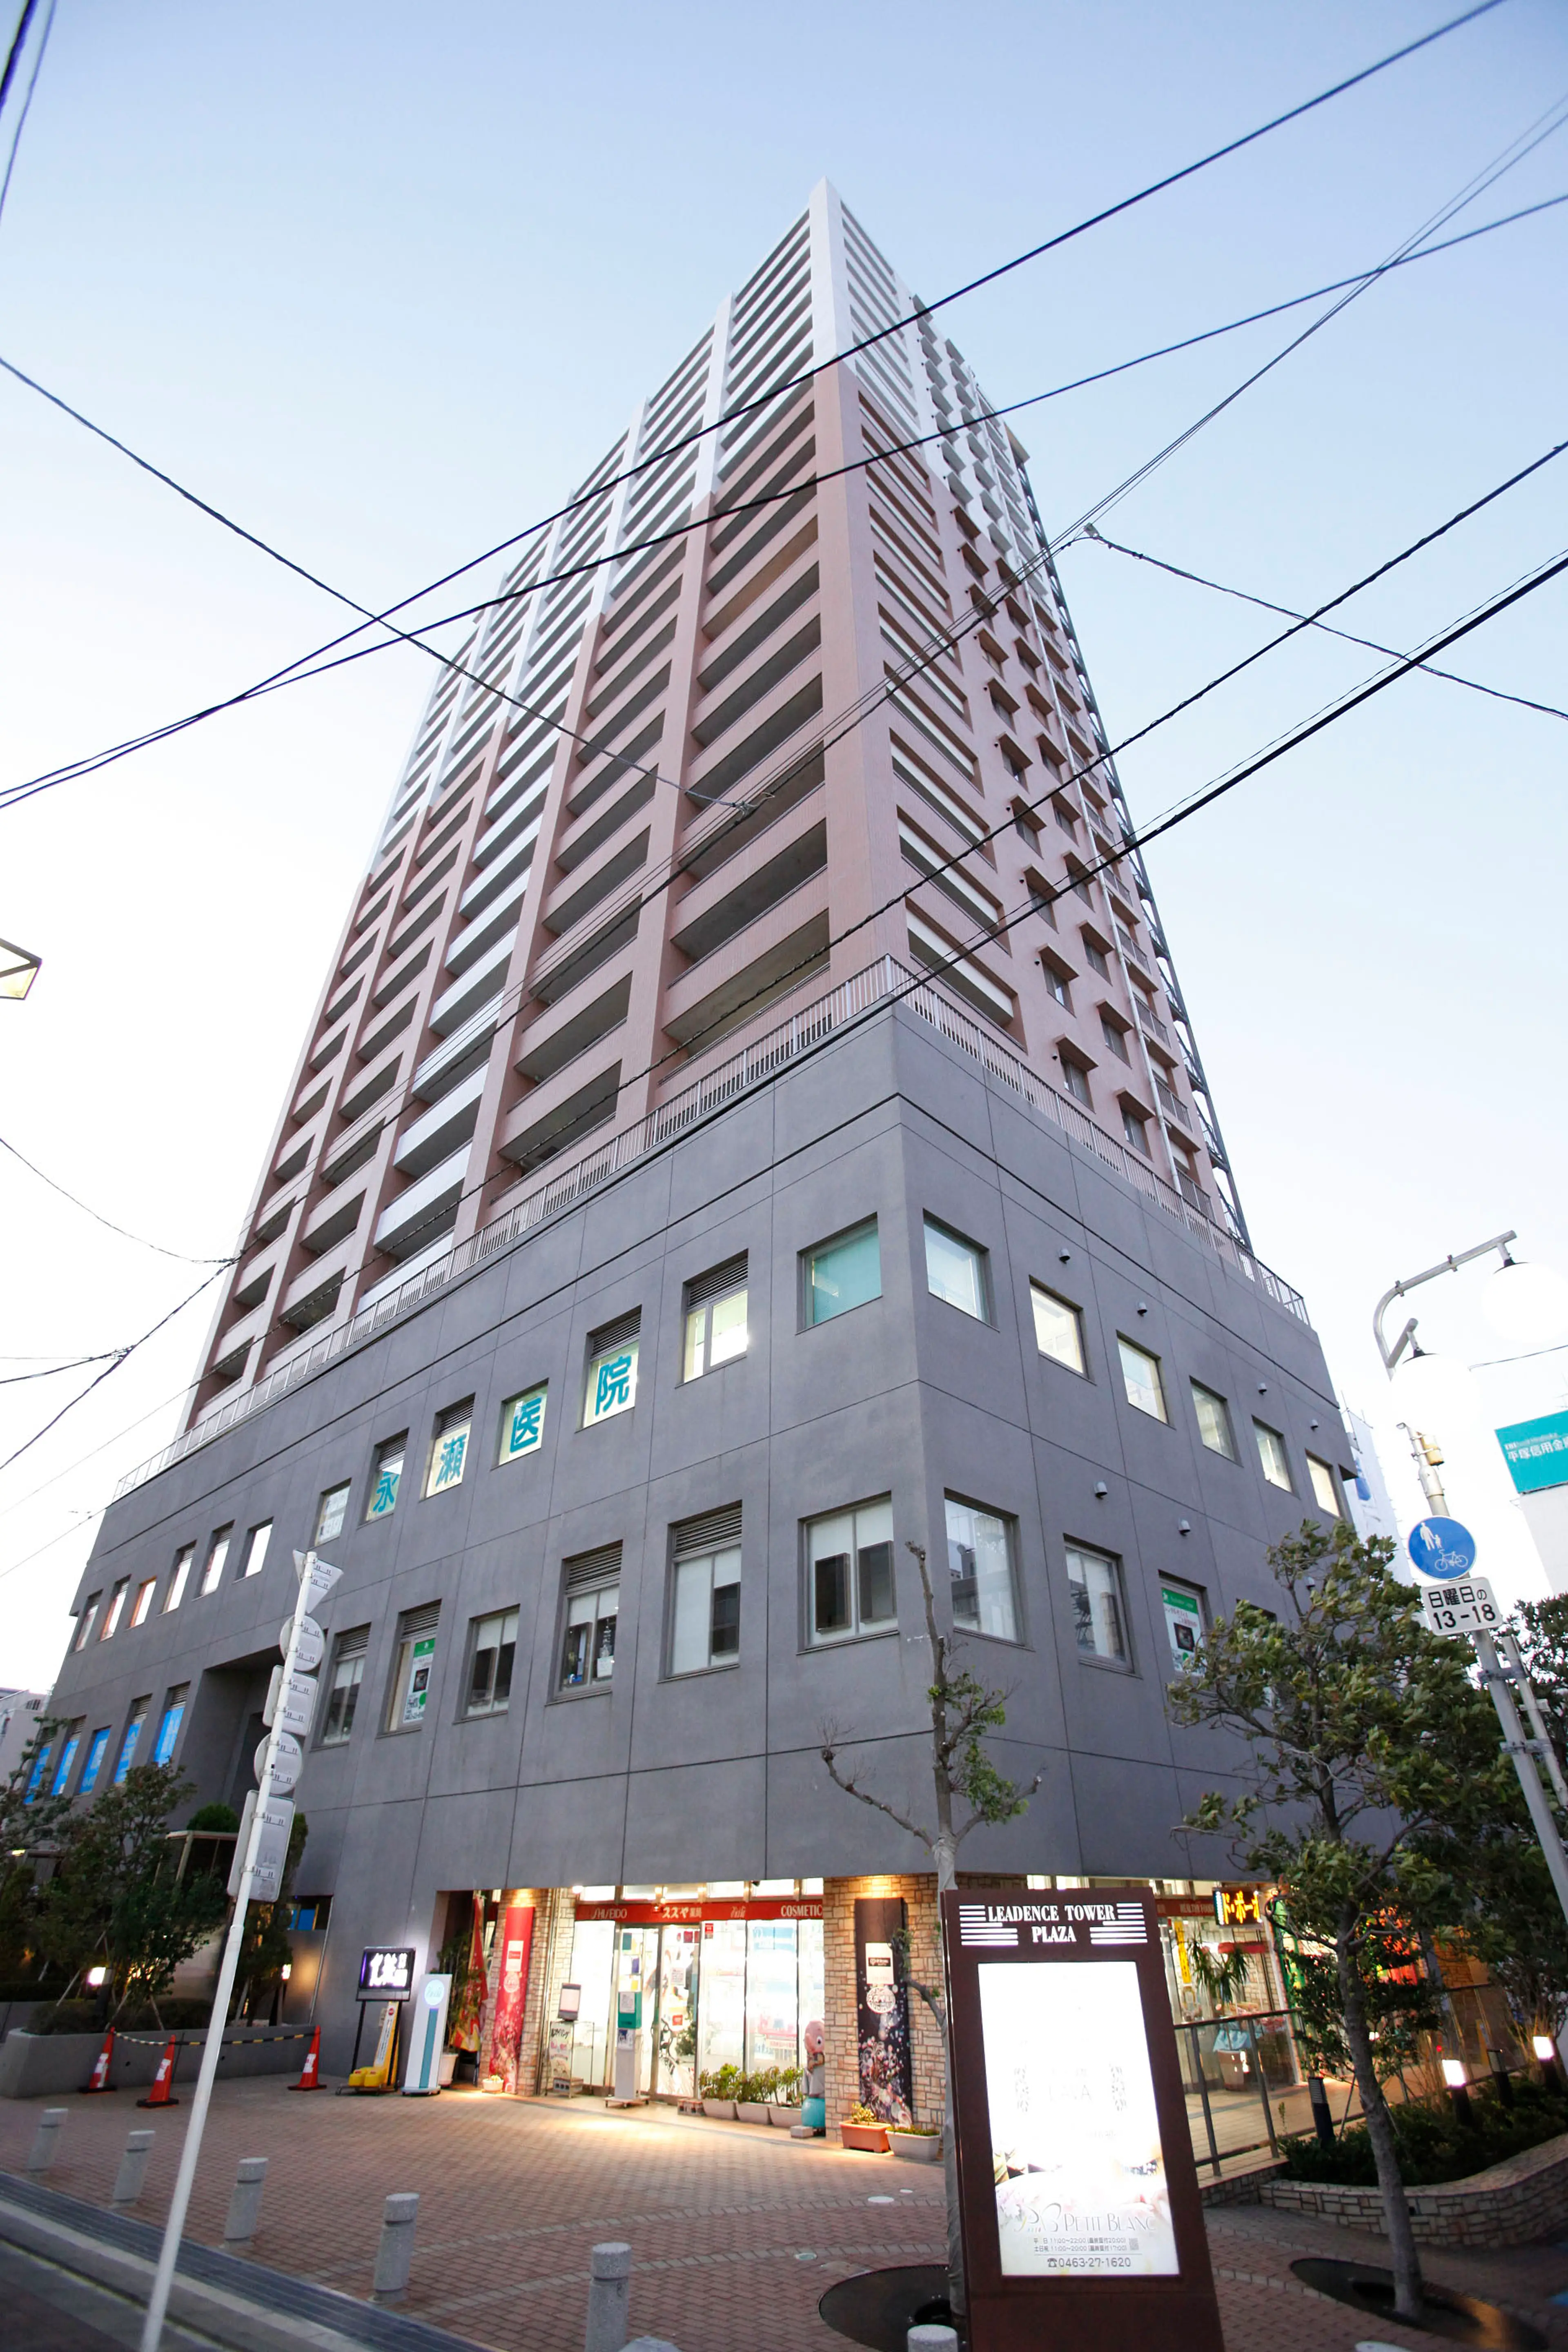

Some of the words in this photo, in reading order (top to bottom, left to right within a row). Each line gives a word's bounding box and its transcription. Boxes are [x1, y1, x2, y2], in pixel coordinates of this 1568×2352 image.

[1428, 1586, 1487, 1608] 日曜日の
[593, 1907, 627, 1919] SHISEIDO
[988, 1905, 1059, 1922] LEADENCE
[1064, 1904, 1116, 1921] TOWER
[1031, 1926, 1077, 1943] PLAZA
[1064, 2213, 1101, 2231] PETIT
[1107, 2212, 1156, 2231] BLANC
